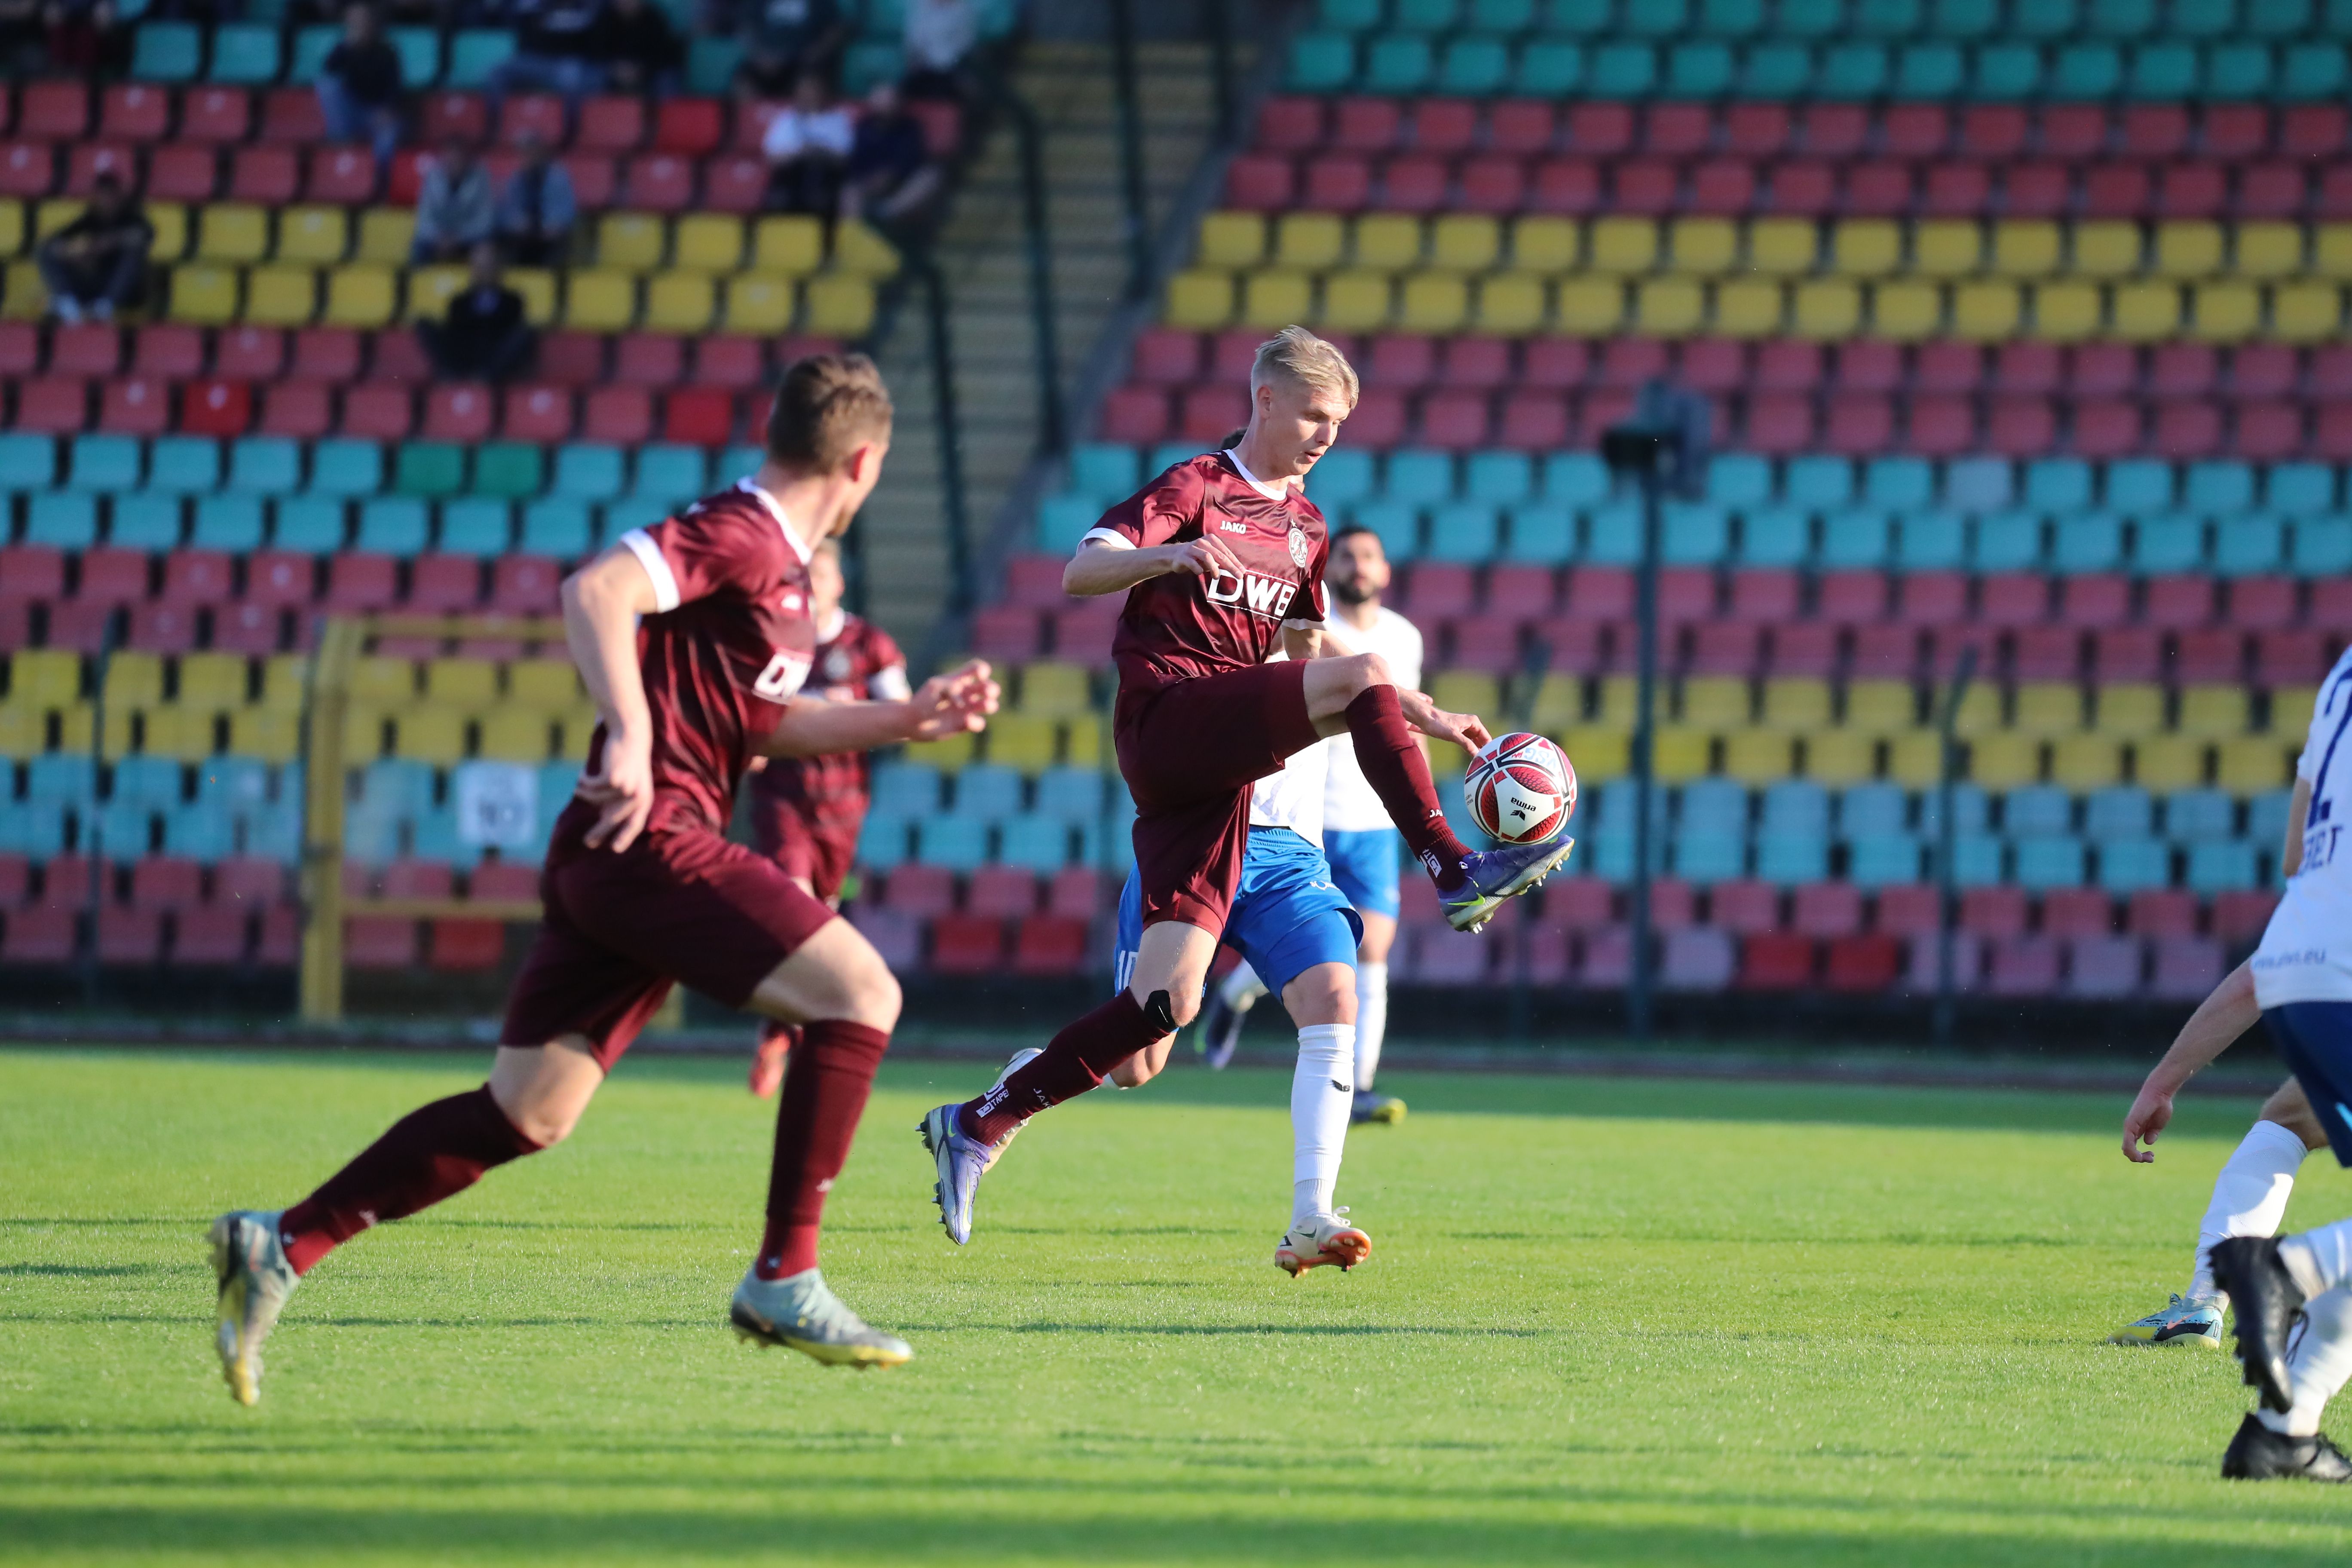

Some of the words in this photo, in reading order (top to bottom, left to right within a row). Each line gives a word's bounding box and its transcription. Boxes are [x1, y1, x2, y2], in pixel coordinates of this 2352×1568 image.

[1220, 520, 1246, 534] JAKO
[1207, 569, 1296, 617] DWB
[1511, 797, 1536, 812] erima
